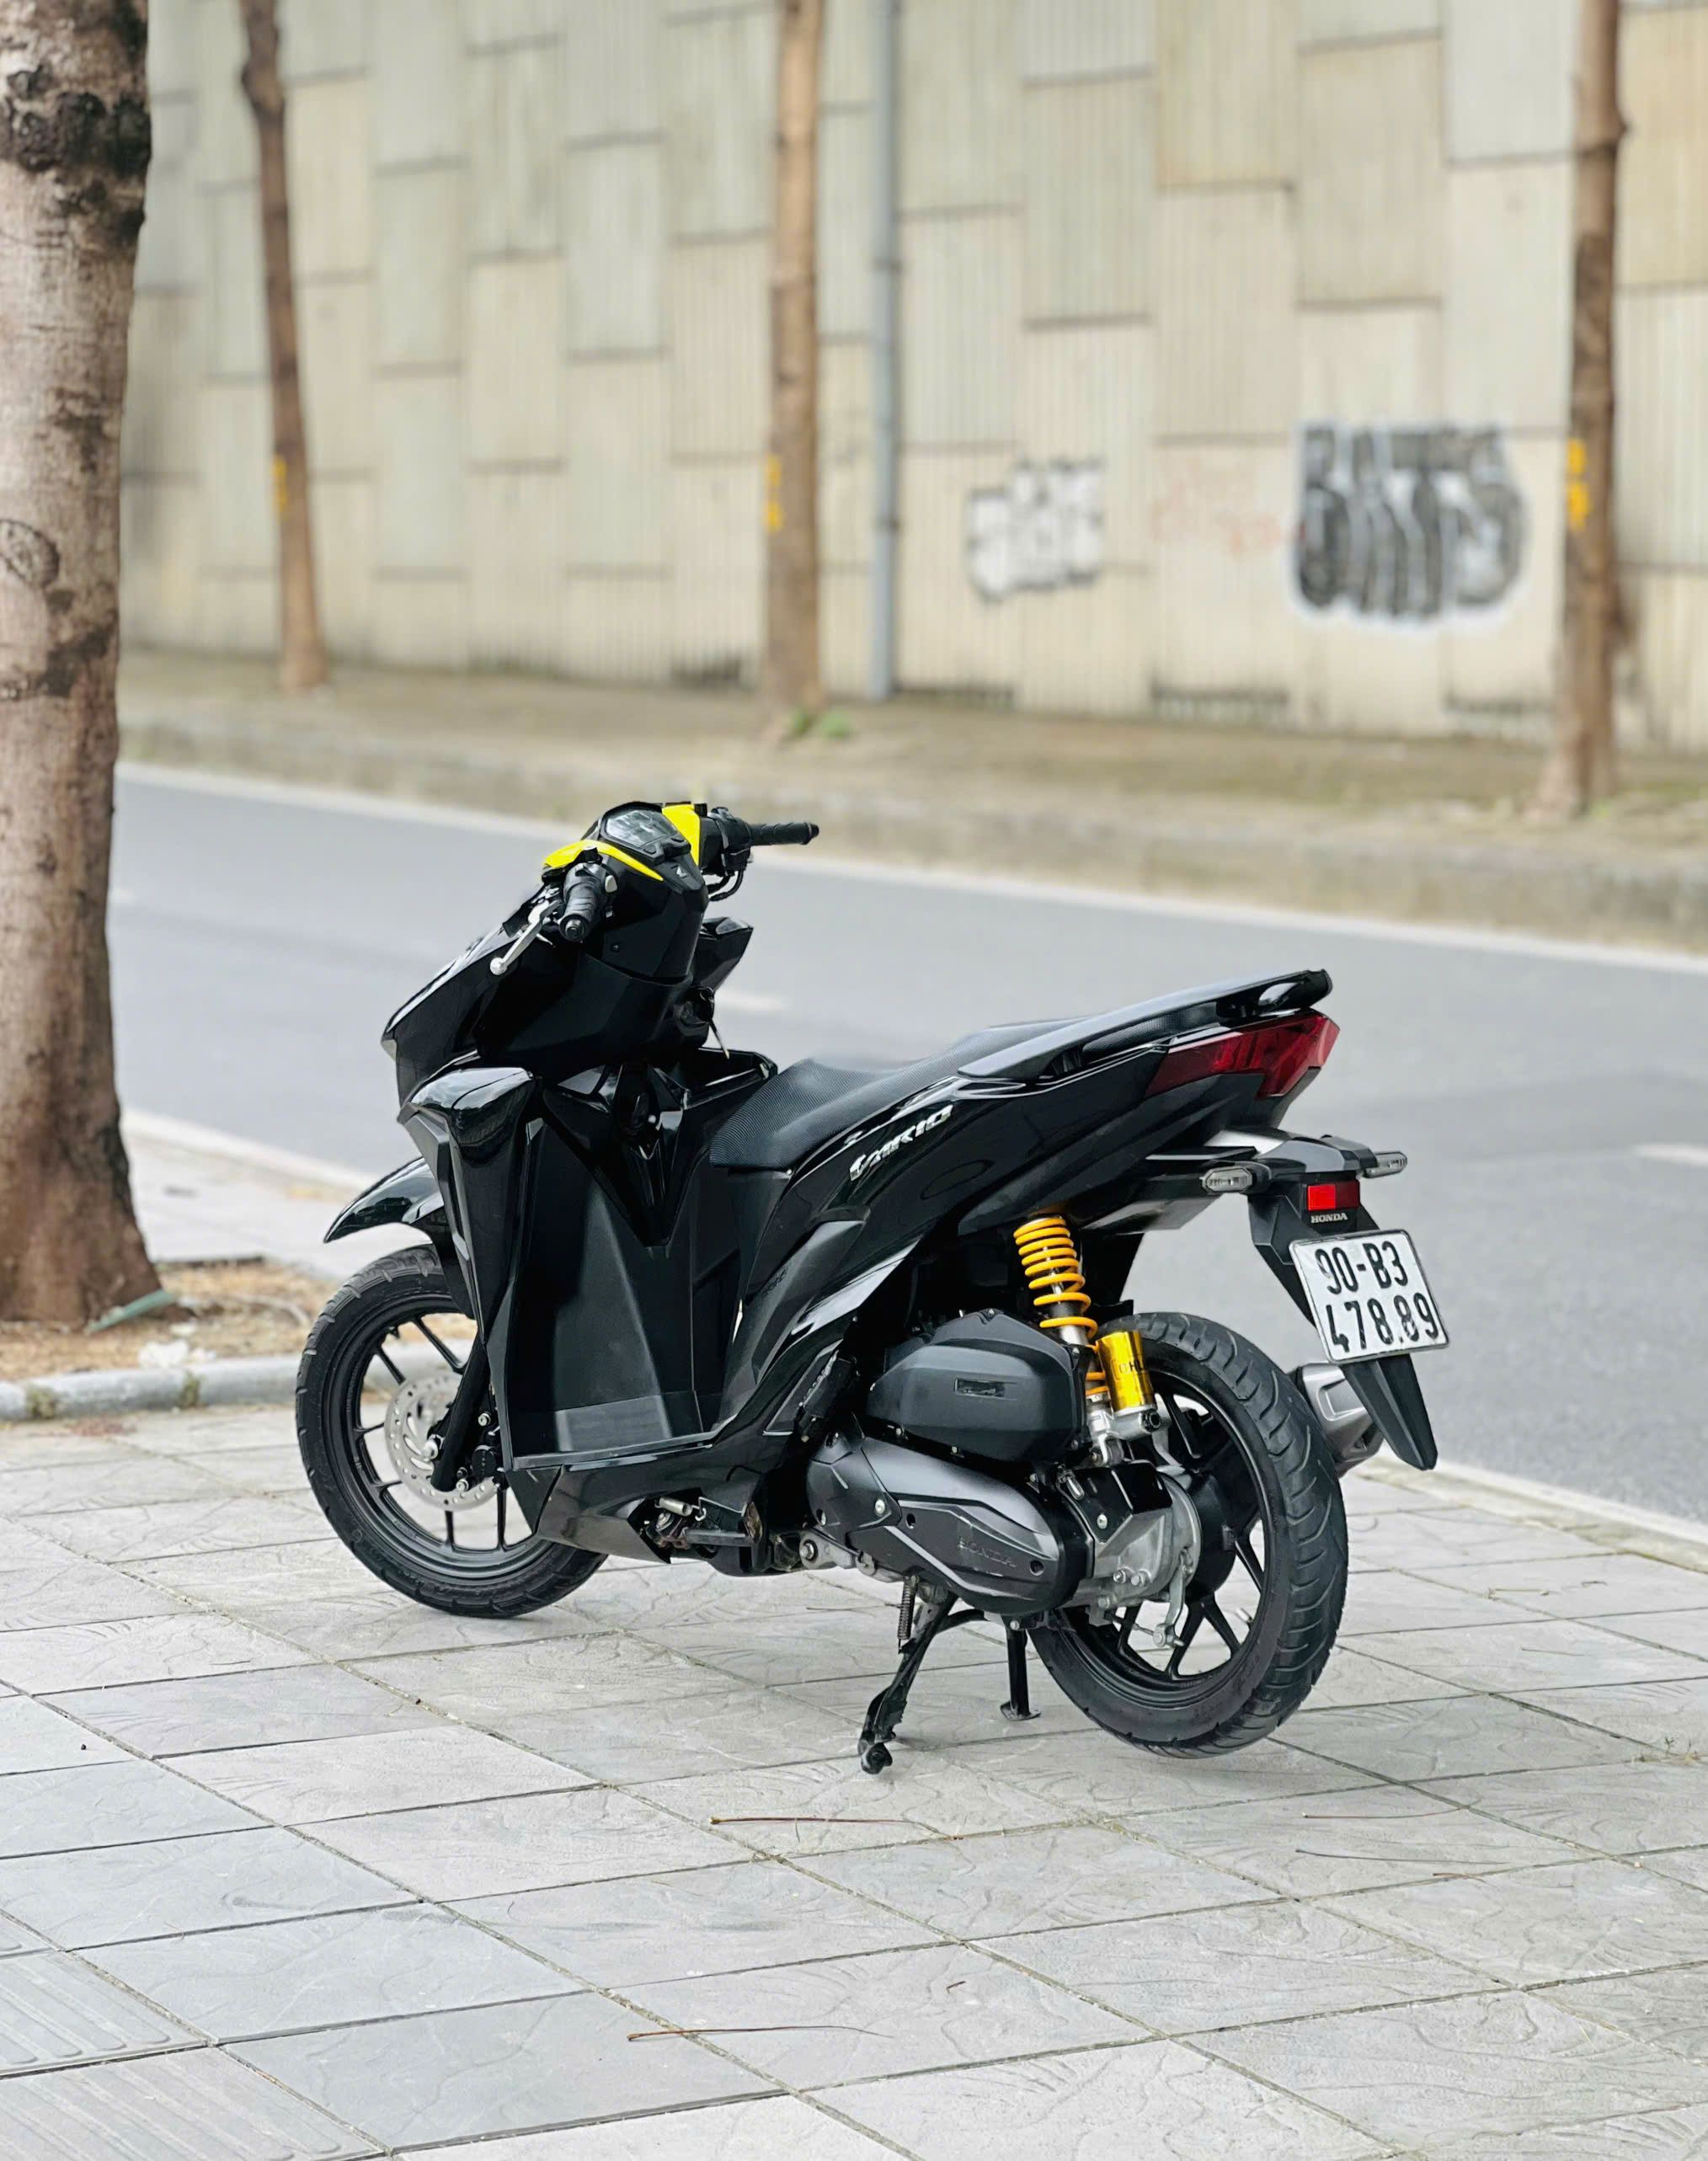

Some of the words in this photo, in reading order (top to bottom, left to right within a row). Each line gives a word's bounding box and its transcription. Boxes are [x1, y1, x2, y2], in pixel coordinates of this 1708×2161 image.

[1310, 1213, 1348, 1224] HONDA
[1315, 1241, 1408, 1294] 90-B3
[1326, 1293, 1438, 1353] 478.89
